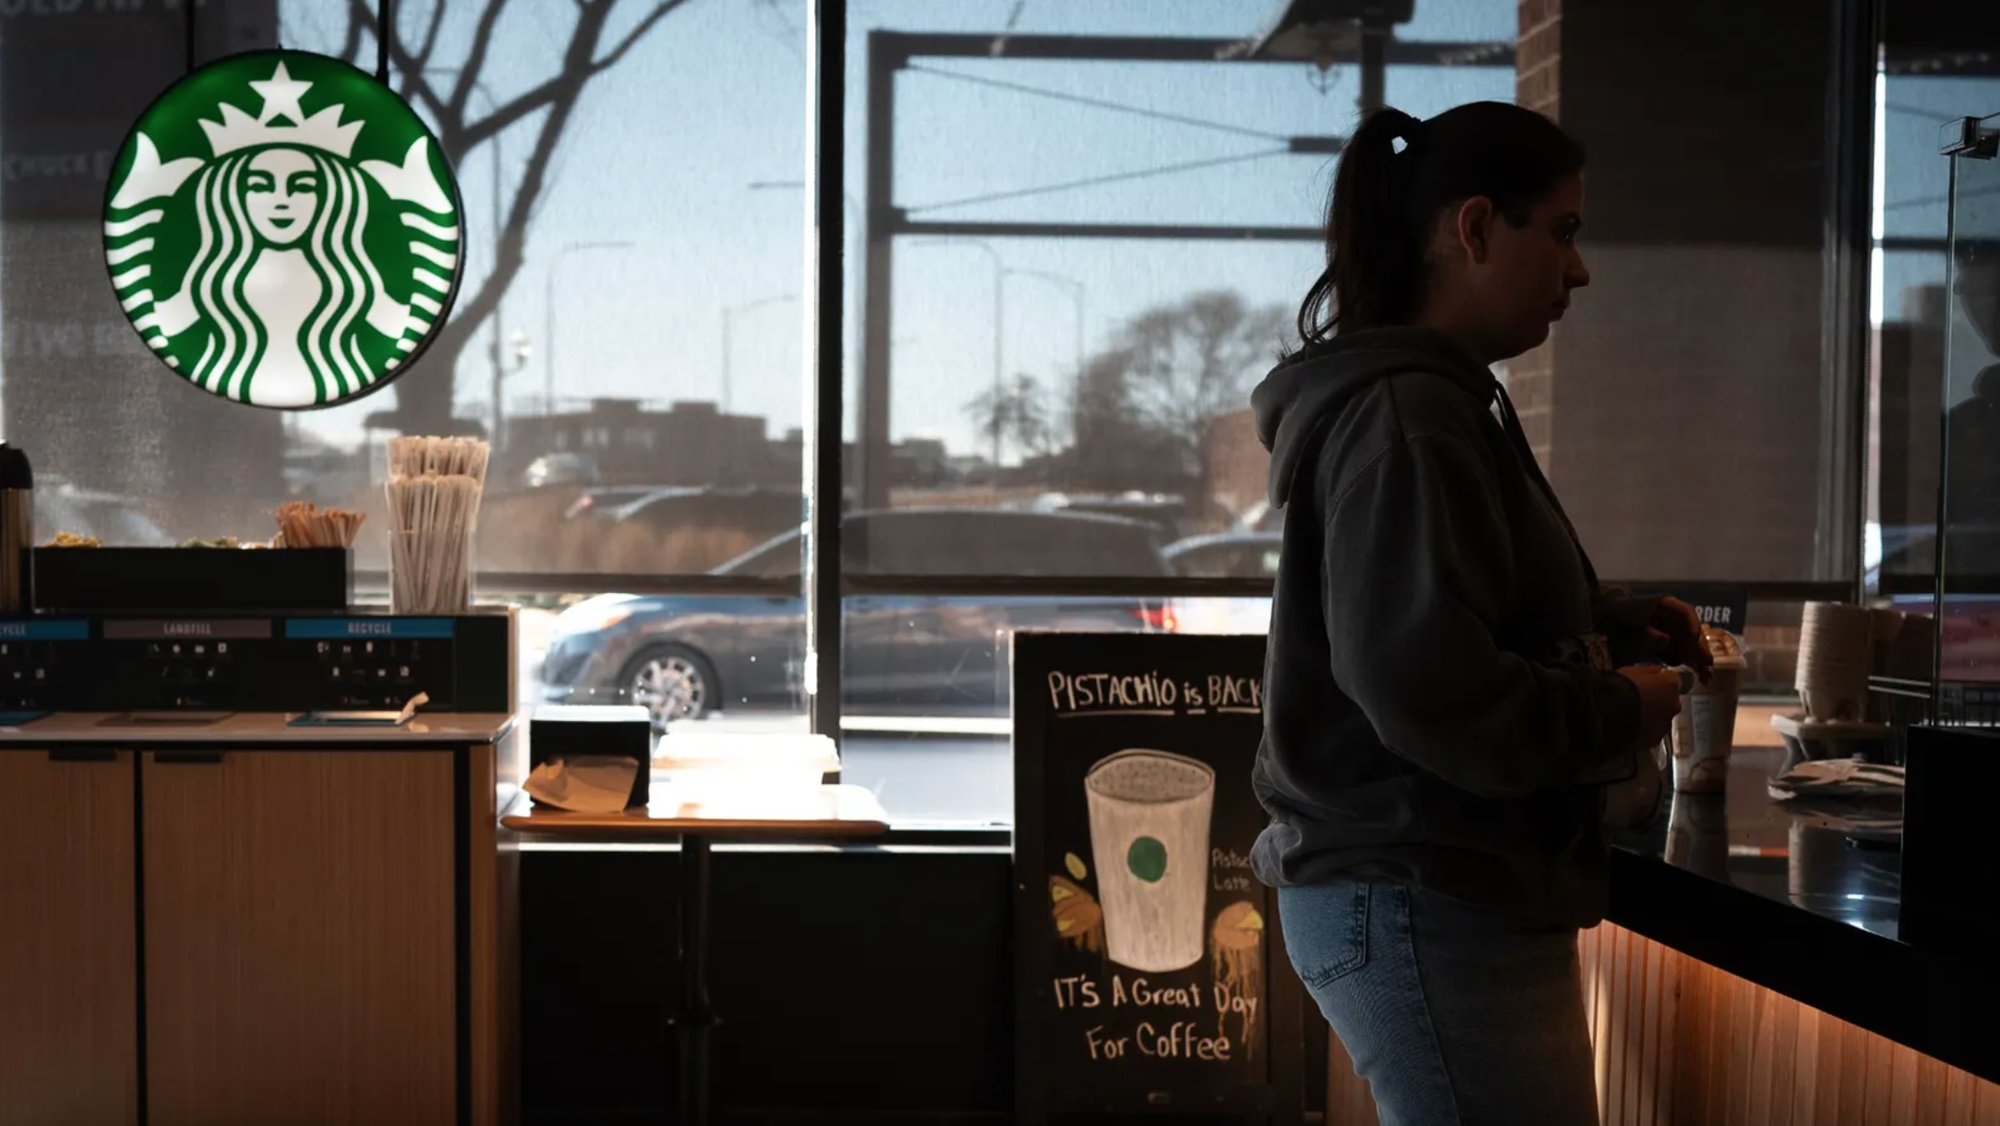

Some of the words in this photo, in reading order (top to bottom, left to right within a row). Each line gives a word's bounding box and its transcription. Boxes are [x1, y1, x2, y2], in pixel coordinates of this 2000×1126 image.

[1694, 605, 1731, 623] RDER
[163, 623, 212, 635] LANDFILL
[347, 622, 393, 635] RECYCLE
[1207, 674, 1262, 706] BACK
[1112, 974, 1128, 1008] A
[1131, 977, 1201, 1008] Great
[1213, 980, 1257, 1024] Day
[1086, 1025, 1129, 1060] For
[1136, 1021, 1231, 1060] Coffee
